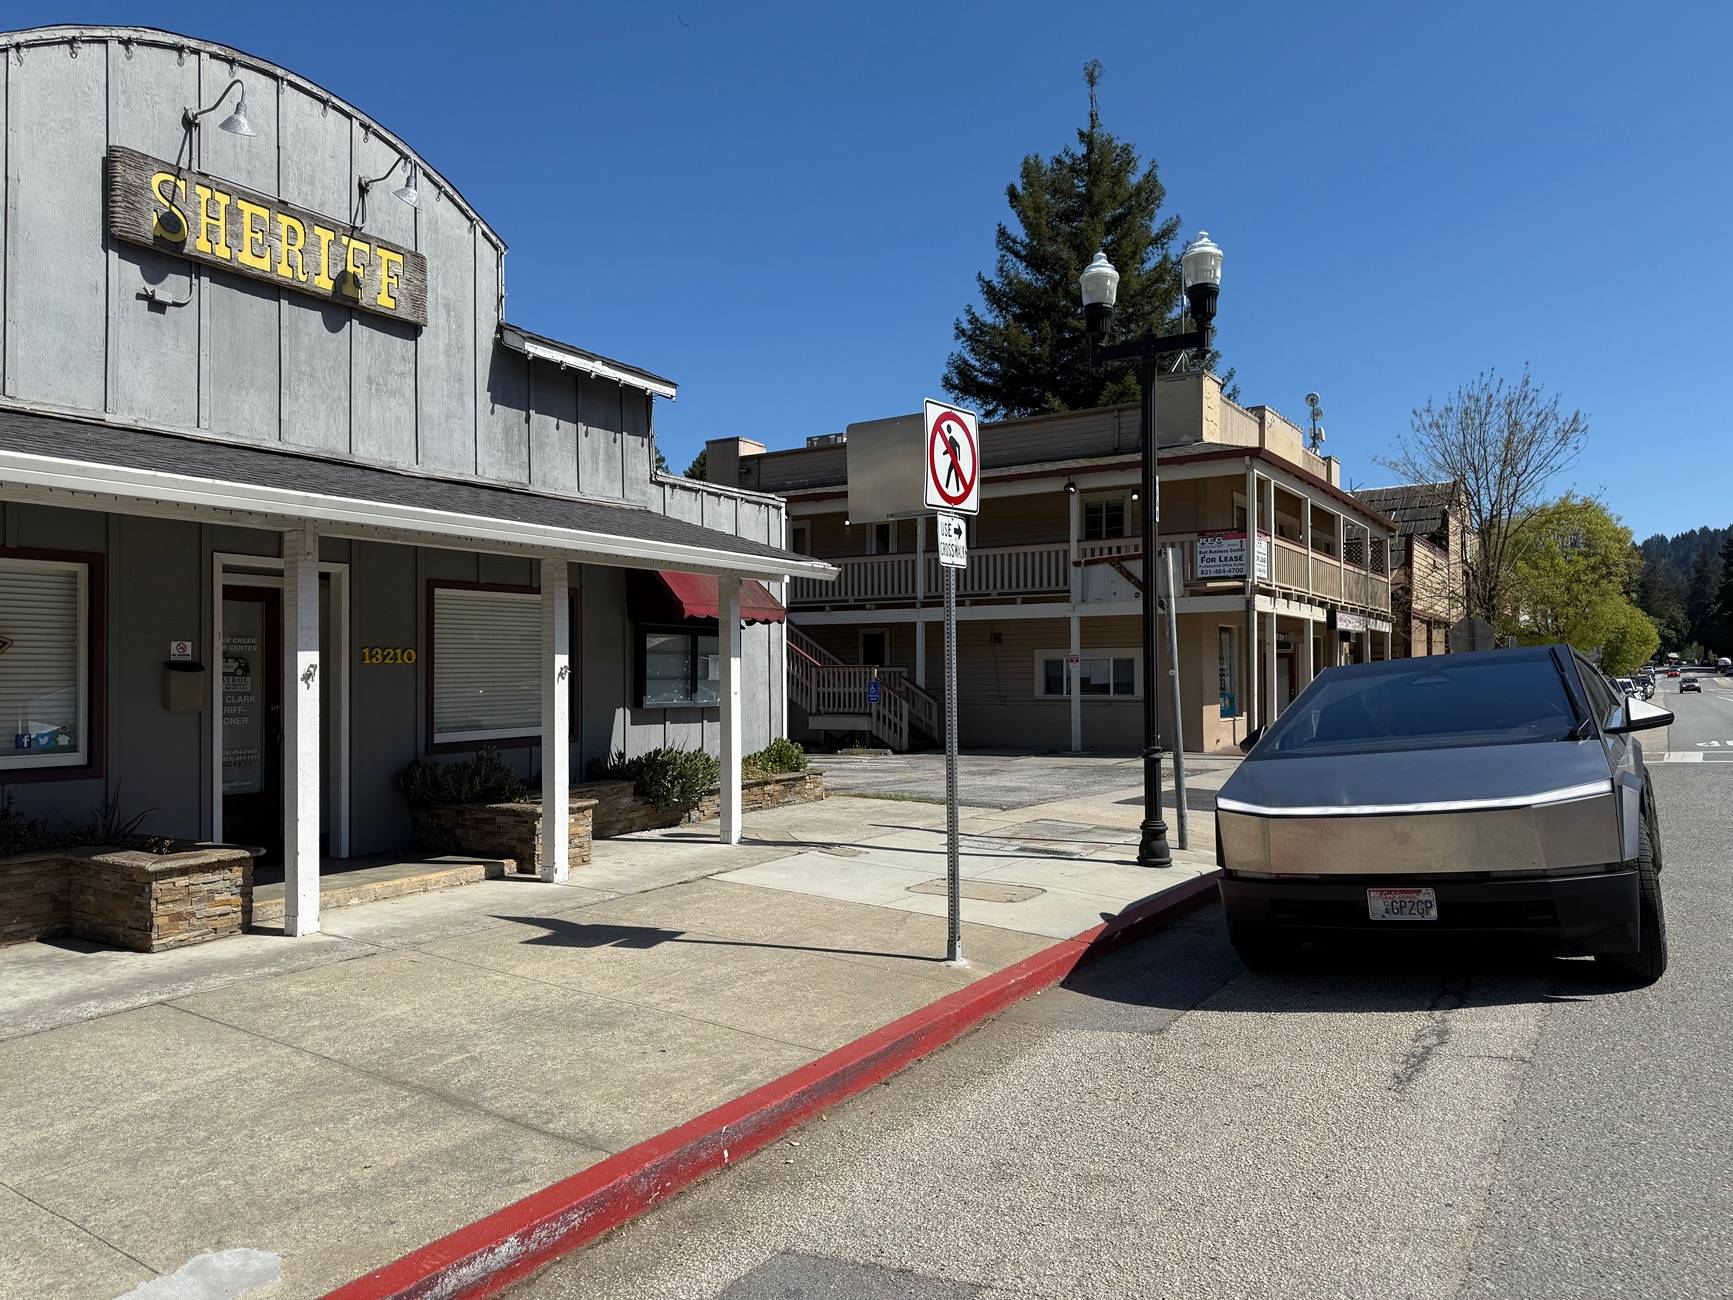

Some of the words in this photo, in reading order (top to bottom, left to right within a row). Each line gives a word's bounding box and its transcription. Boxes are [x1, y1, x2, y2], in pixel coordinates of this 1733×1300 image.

[150, 170, 405, 310] SHERIFF
[941, 522, 953, 538] USE
[940, 541, 967, 559] CROSSWALK
[362, 647, 417, 664] 13210
[225, 695, 256, 704] CLARK
[1391, 899, 1432, 915] GP2GP
